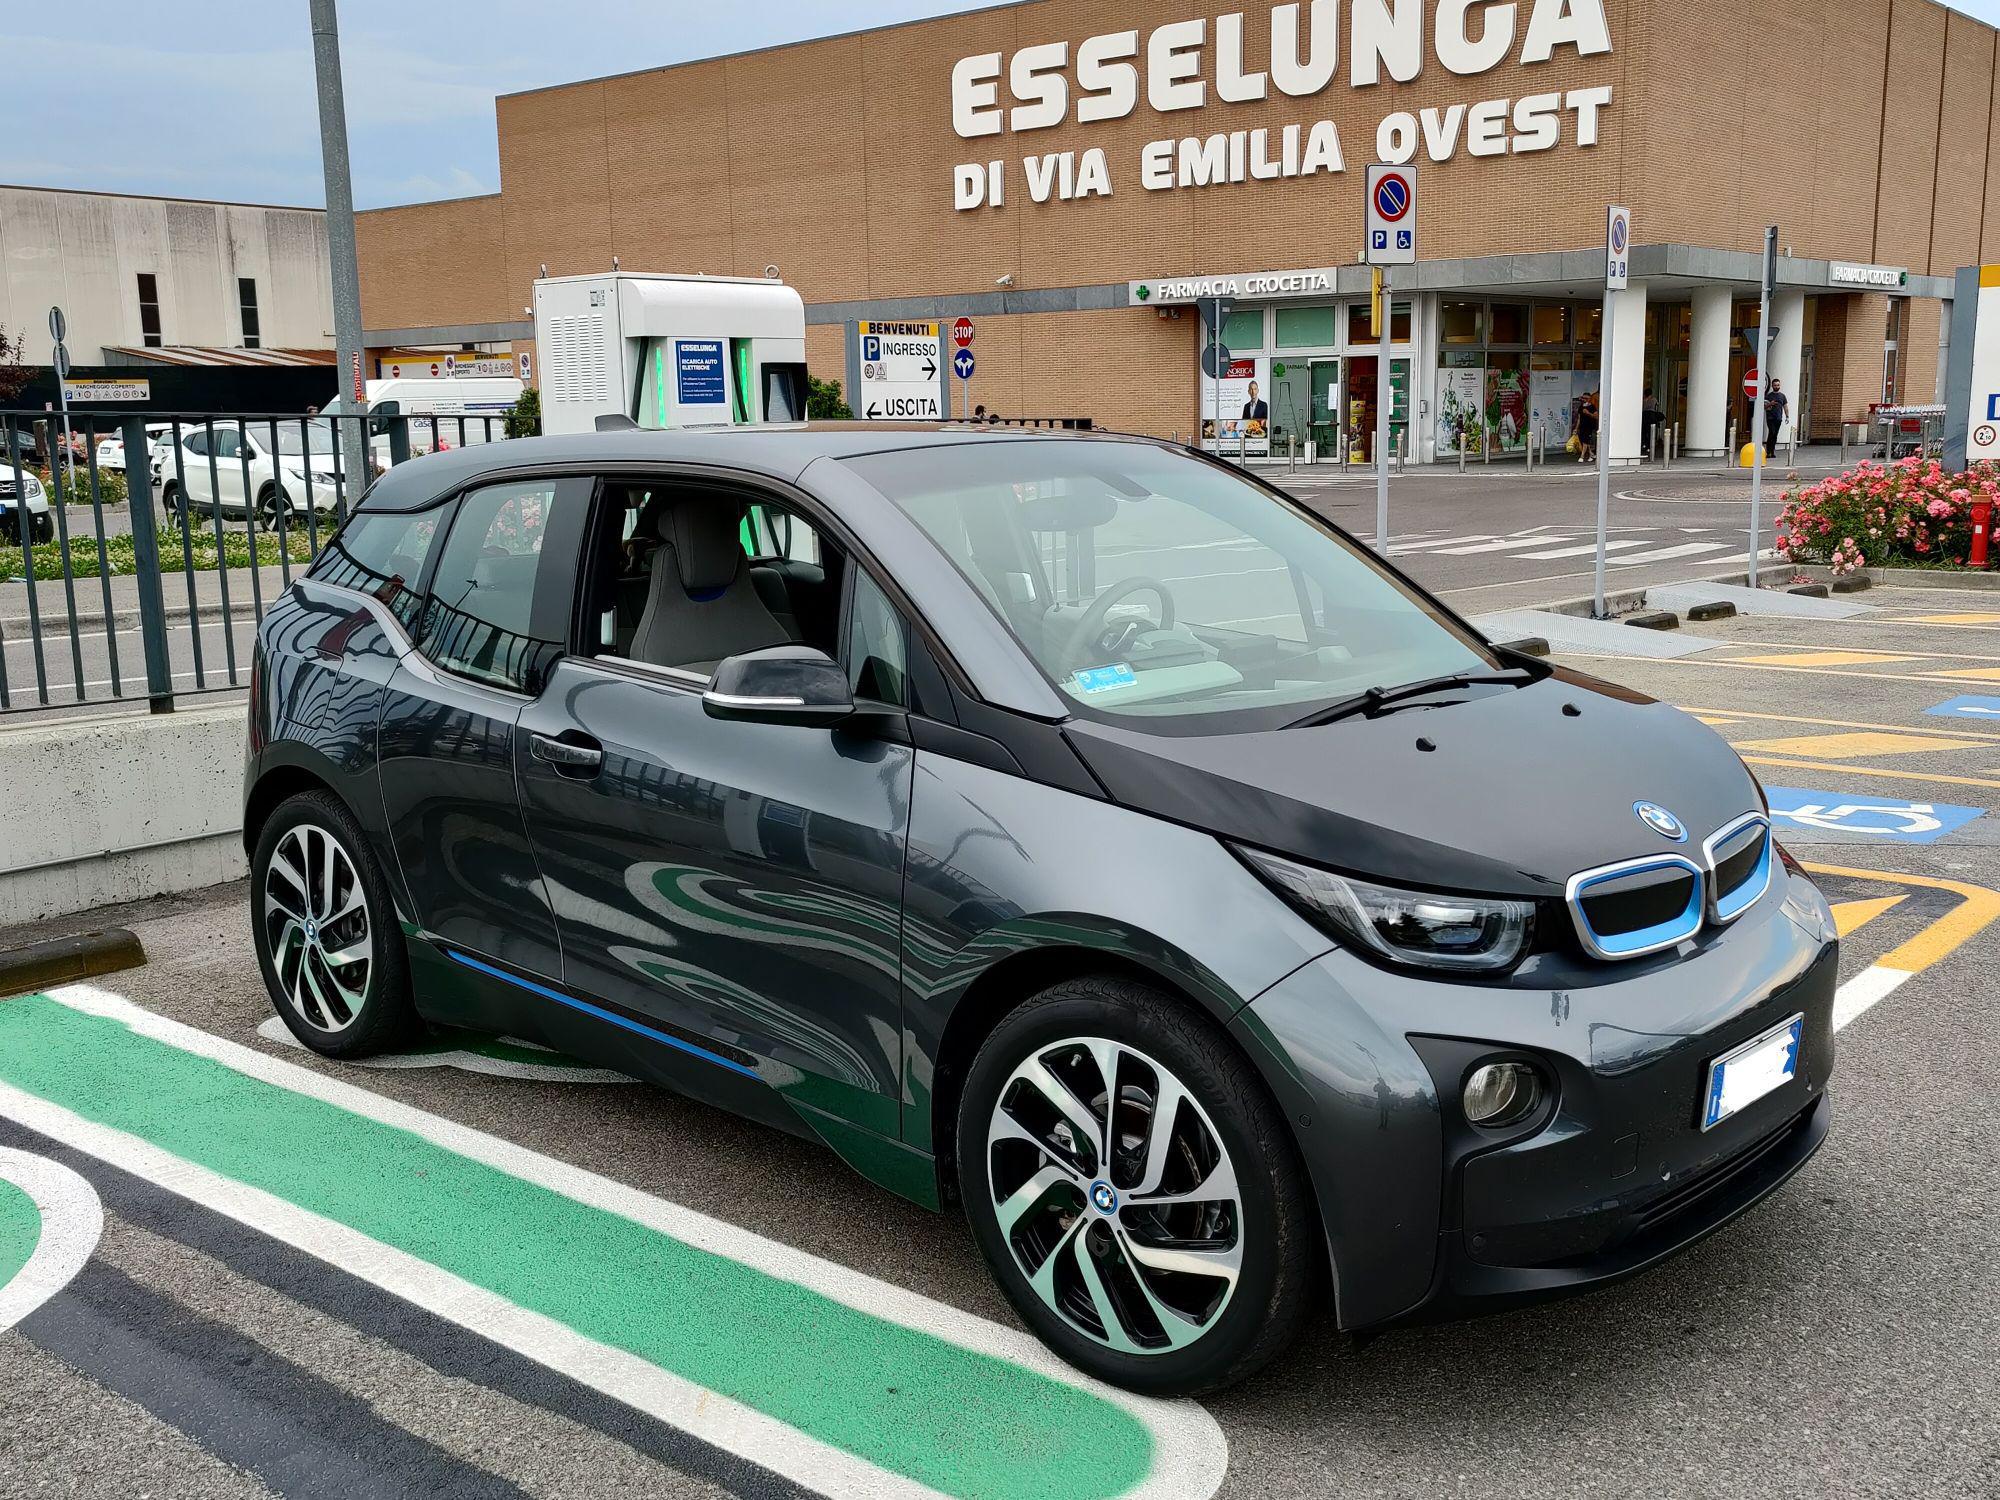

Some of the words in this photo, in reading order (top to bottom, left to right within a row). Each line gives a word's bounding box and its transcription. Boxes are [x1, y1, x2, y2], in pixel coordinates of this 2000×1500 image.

[952, 0, 1613, 138] ESSELUNGA
[953, 160, 1005, 211] DI
[1023, 148, 1113, 203] VIA
[1141, 120, 1347, 190] EMILIA
[1376, 86, 1613, 165] OVEST
[1834, 266, 1867, 283] FARMACIA
[1868, 269, 1899, 285] CROCETTA
[1158, 279, 1239, 299] FARMACIA
[1245, 273, 1331, 293] CROCETTA
[868, 322, 930, 336] BENVENUTI
[954, 326, 973, 339] STOP
[681, 344, 718, 352] ESSELUNGA
[882, 342, 937, 357] INGRESSO
[886, 398, 938, 417] USCITA
